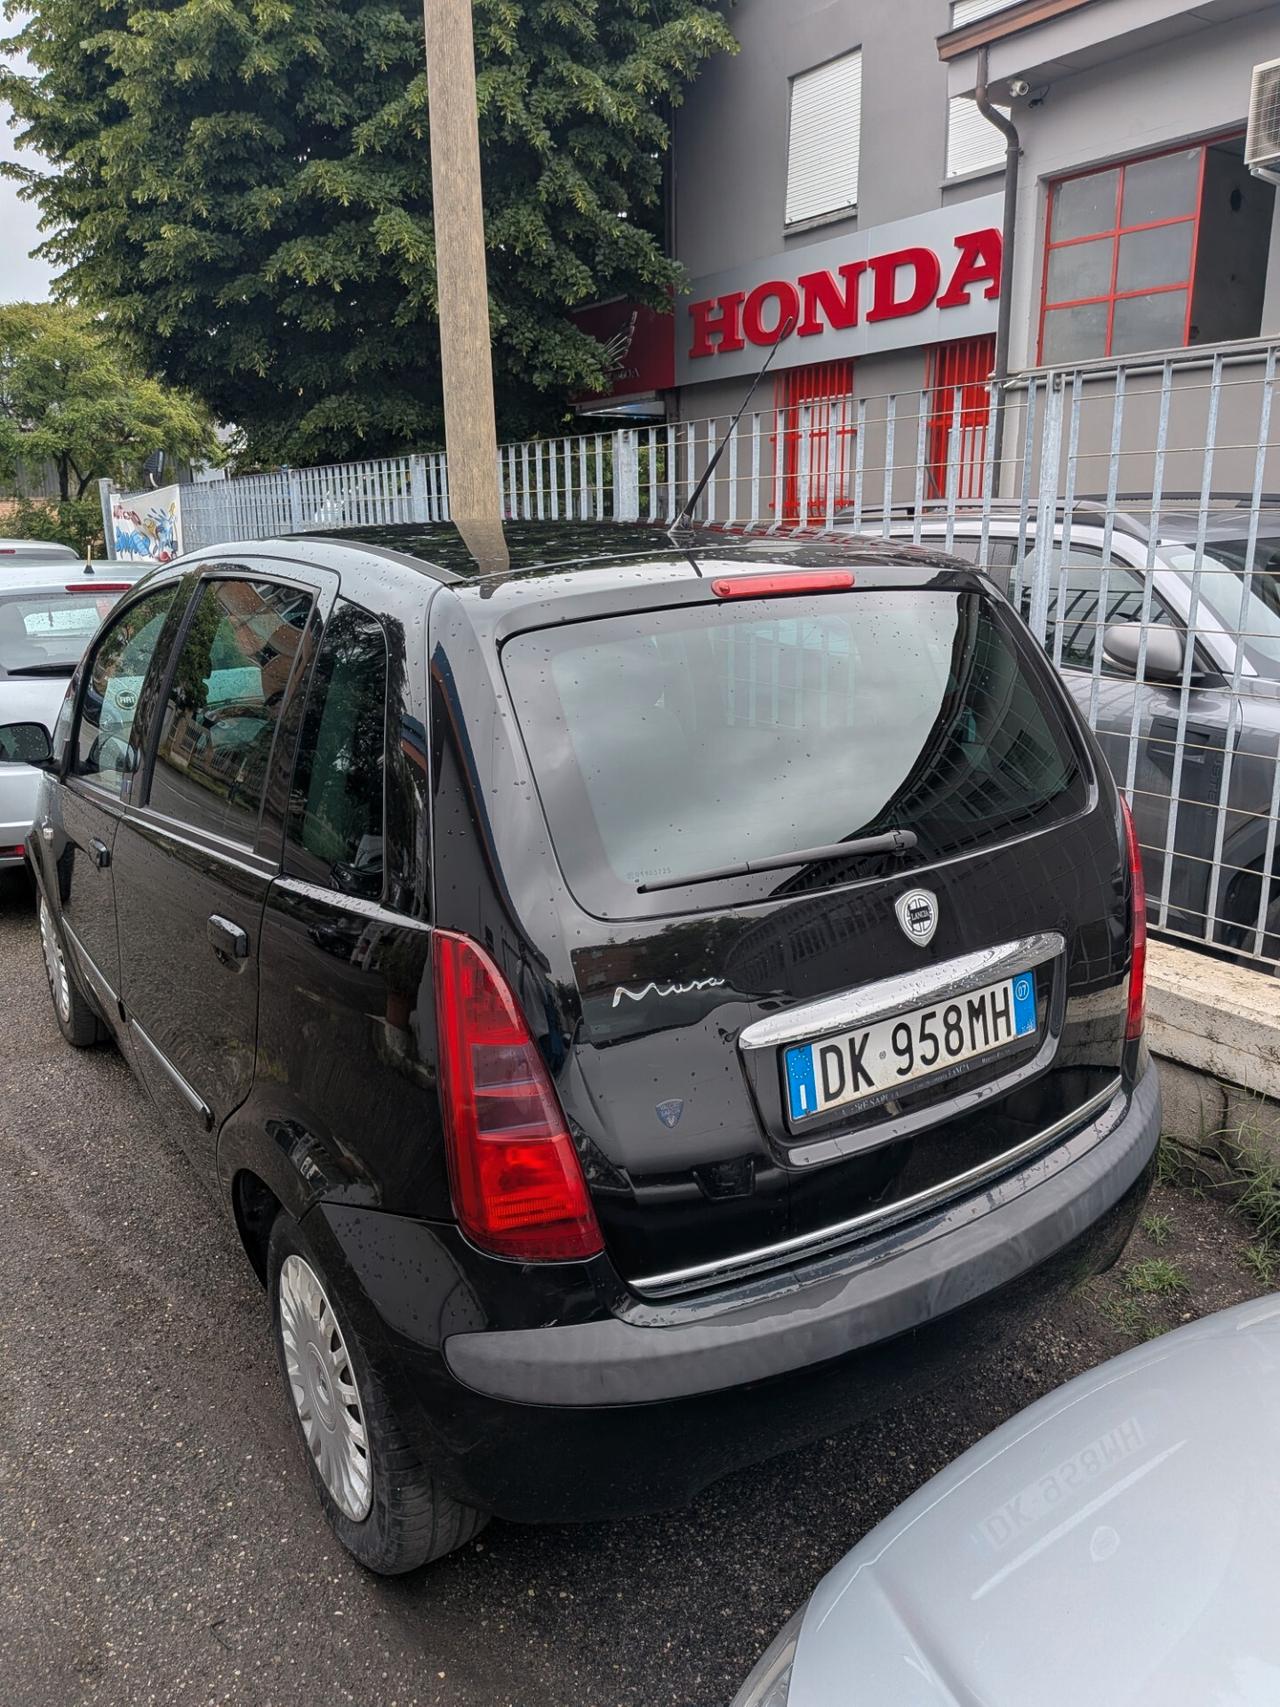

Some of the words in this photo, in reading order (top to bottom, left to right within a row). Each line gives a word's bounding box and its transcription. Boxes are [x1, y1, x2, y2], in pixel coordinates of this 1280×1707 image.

[688, 227, 1004, 360] HONDA
[910, 909, 930, 922] LANCIA
[611, 976, 725, 1008] Musa
[819, 1032, 875, 1102] DK
[891, 986, 1012, 1075] 958MH
